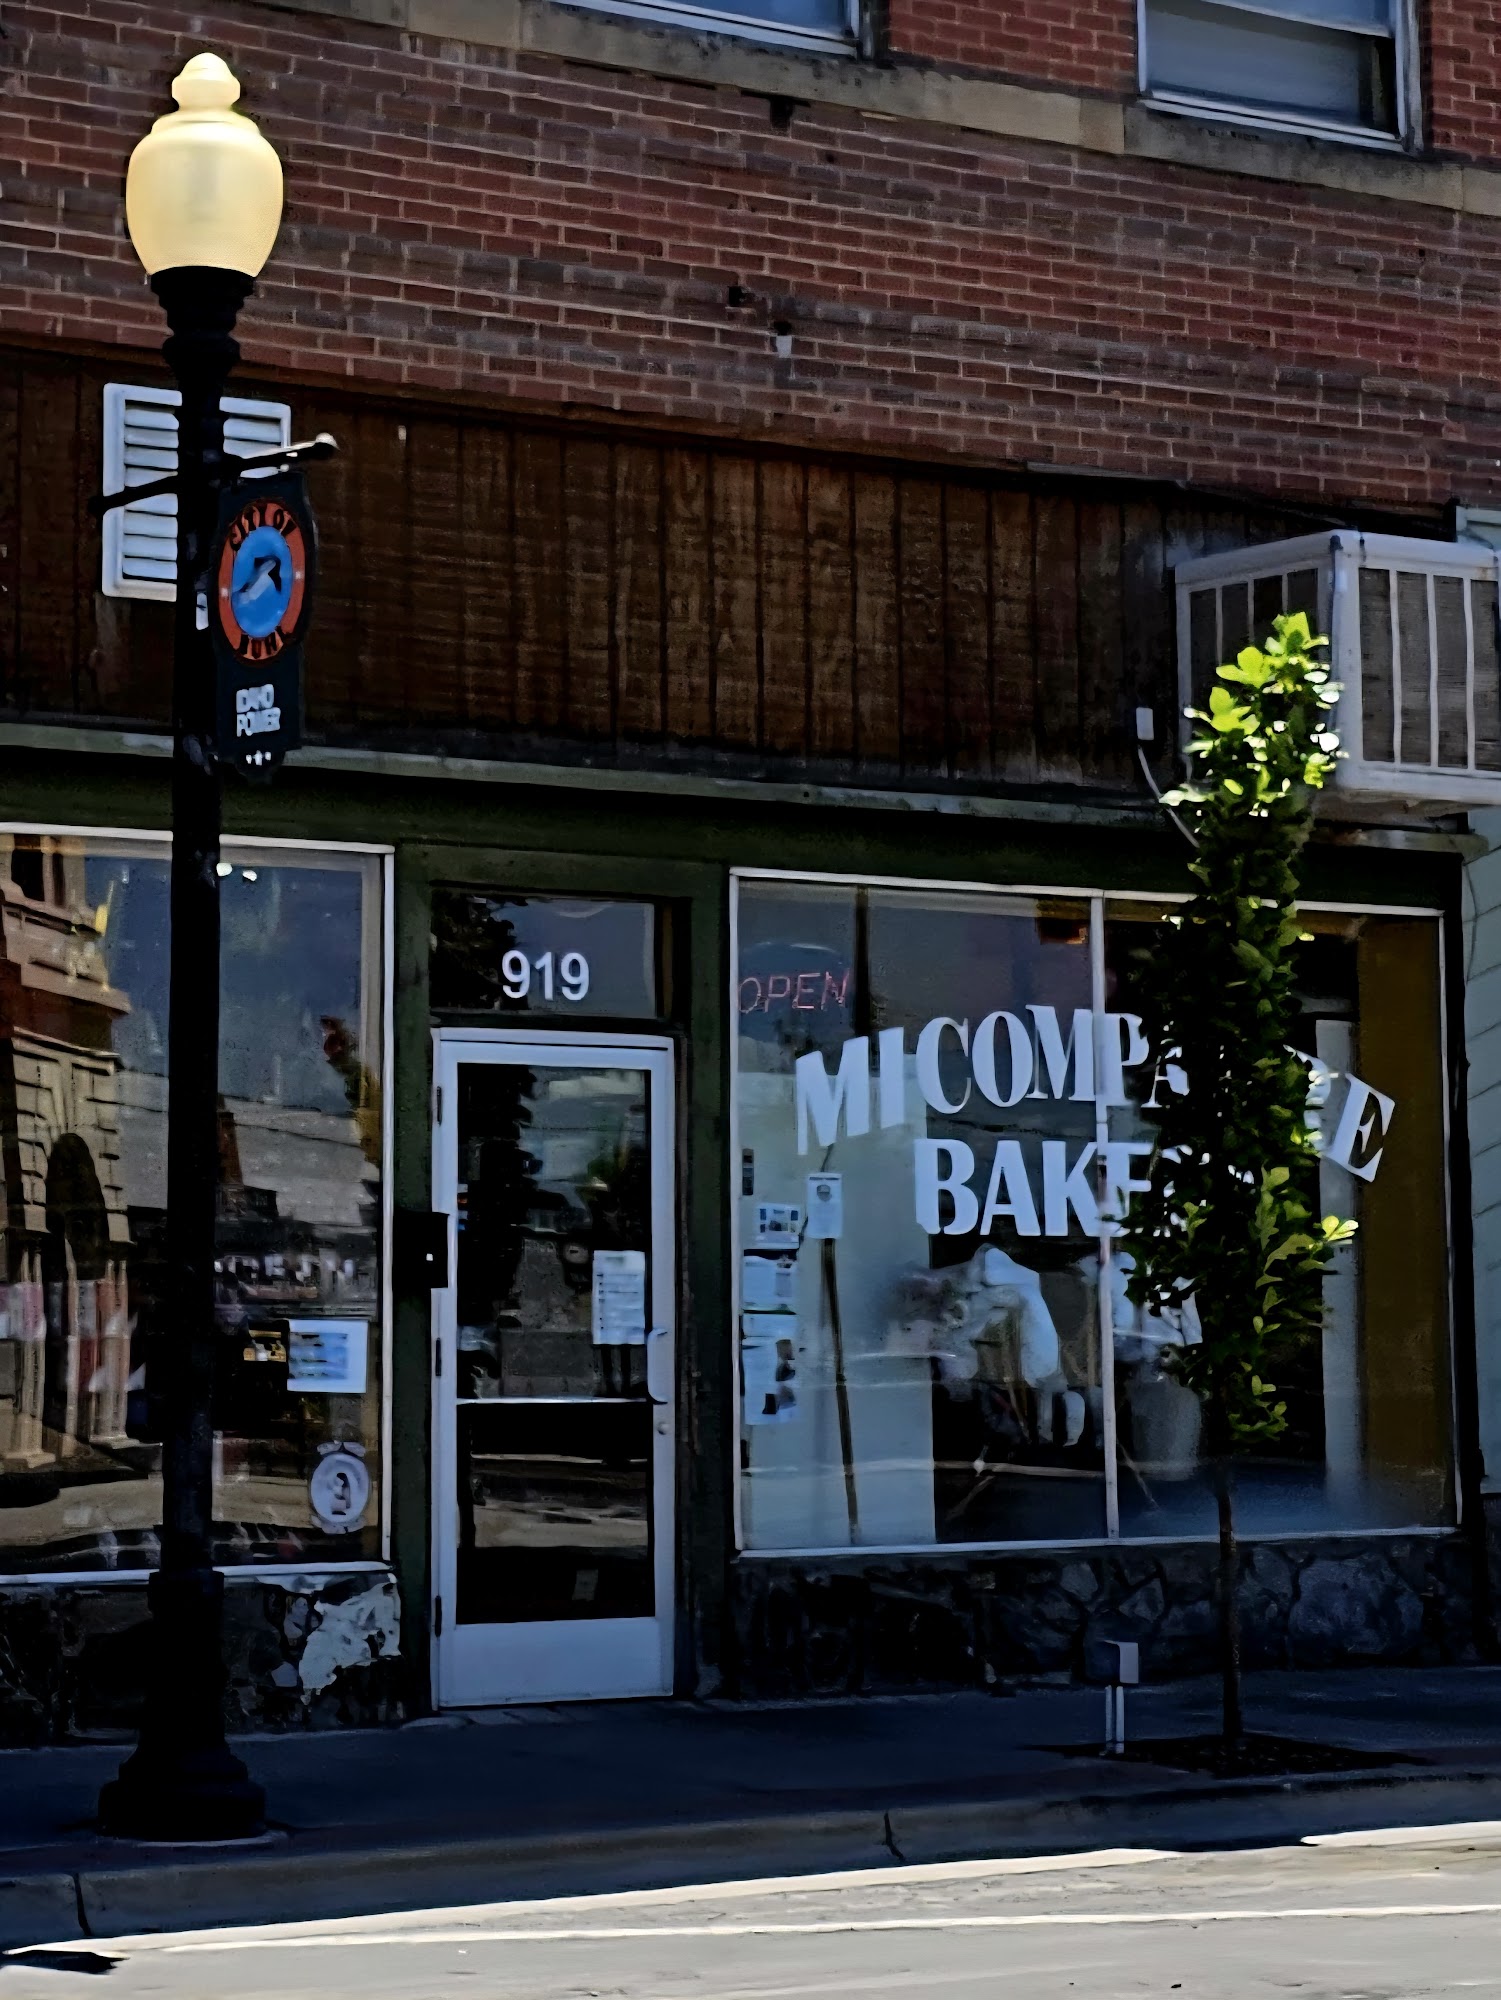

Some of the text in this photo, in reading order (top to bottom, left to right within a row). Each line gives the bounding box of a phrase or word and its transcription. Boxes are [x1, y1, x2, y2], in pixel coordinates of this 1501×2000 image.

[501, 949, 591, 1001] 919
[738, 970, 851, 1015] OPEN
[796, 1004, 1396, 1183] MI COMPAE
[914, 1139, 1250, 1238] BAKE
